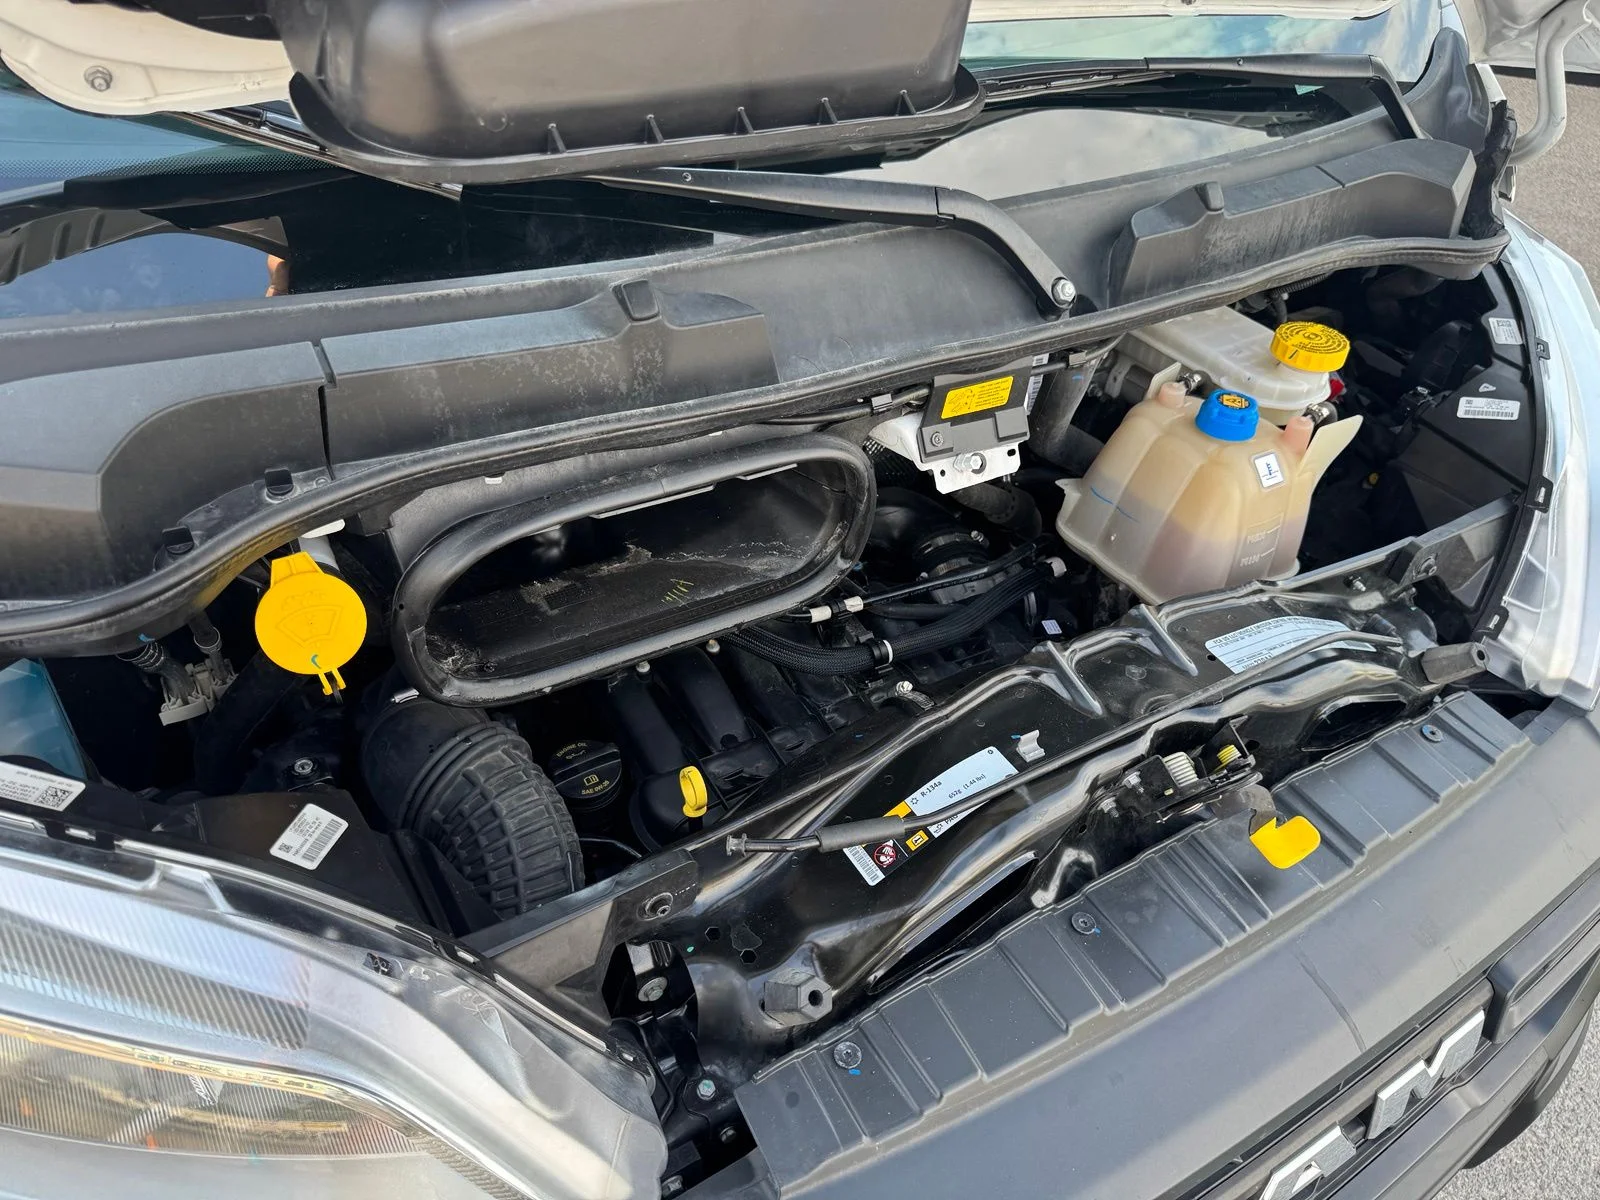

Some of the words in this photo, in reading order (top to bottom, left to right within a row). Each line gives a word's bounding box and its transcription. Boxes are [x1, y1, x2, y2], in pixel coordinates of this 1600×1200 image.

[1240, 553, 1260, 567] MIN
[556, 744, 576, 757] ENGINE
[582, 786, 594, 794] SAE
[920, 780, 943, 797] R-134a
